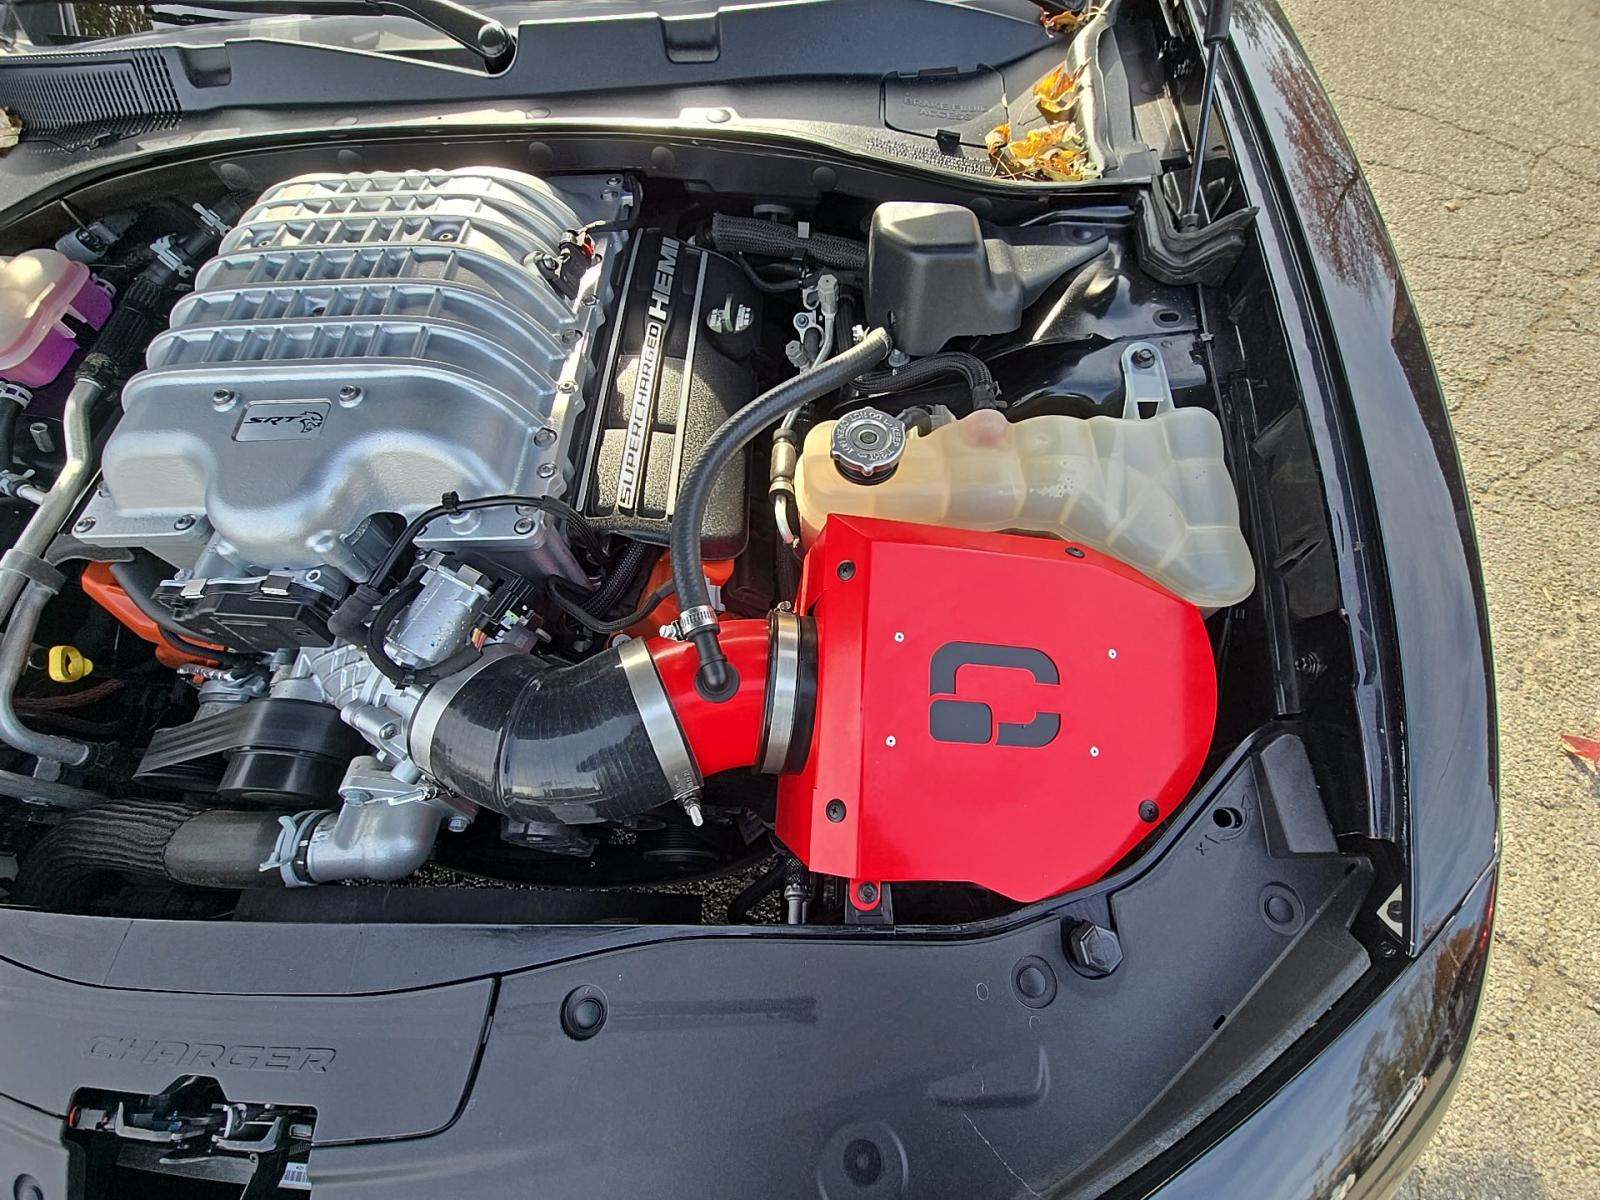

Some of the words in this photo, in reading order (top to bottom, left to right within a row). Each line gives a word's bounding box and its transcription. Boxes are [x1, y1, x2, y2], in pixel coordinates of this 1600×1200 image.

[619, 323, 661, 508] SUPERCHARGED
[648, 236, 680, 321] HEMI
[244, 416, 302, 426] SRT
[90, 1036, 338, 1074] CHARGER
